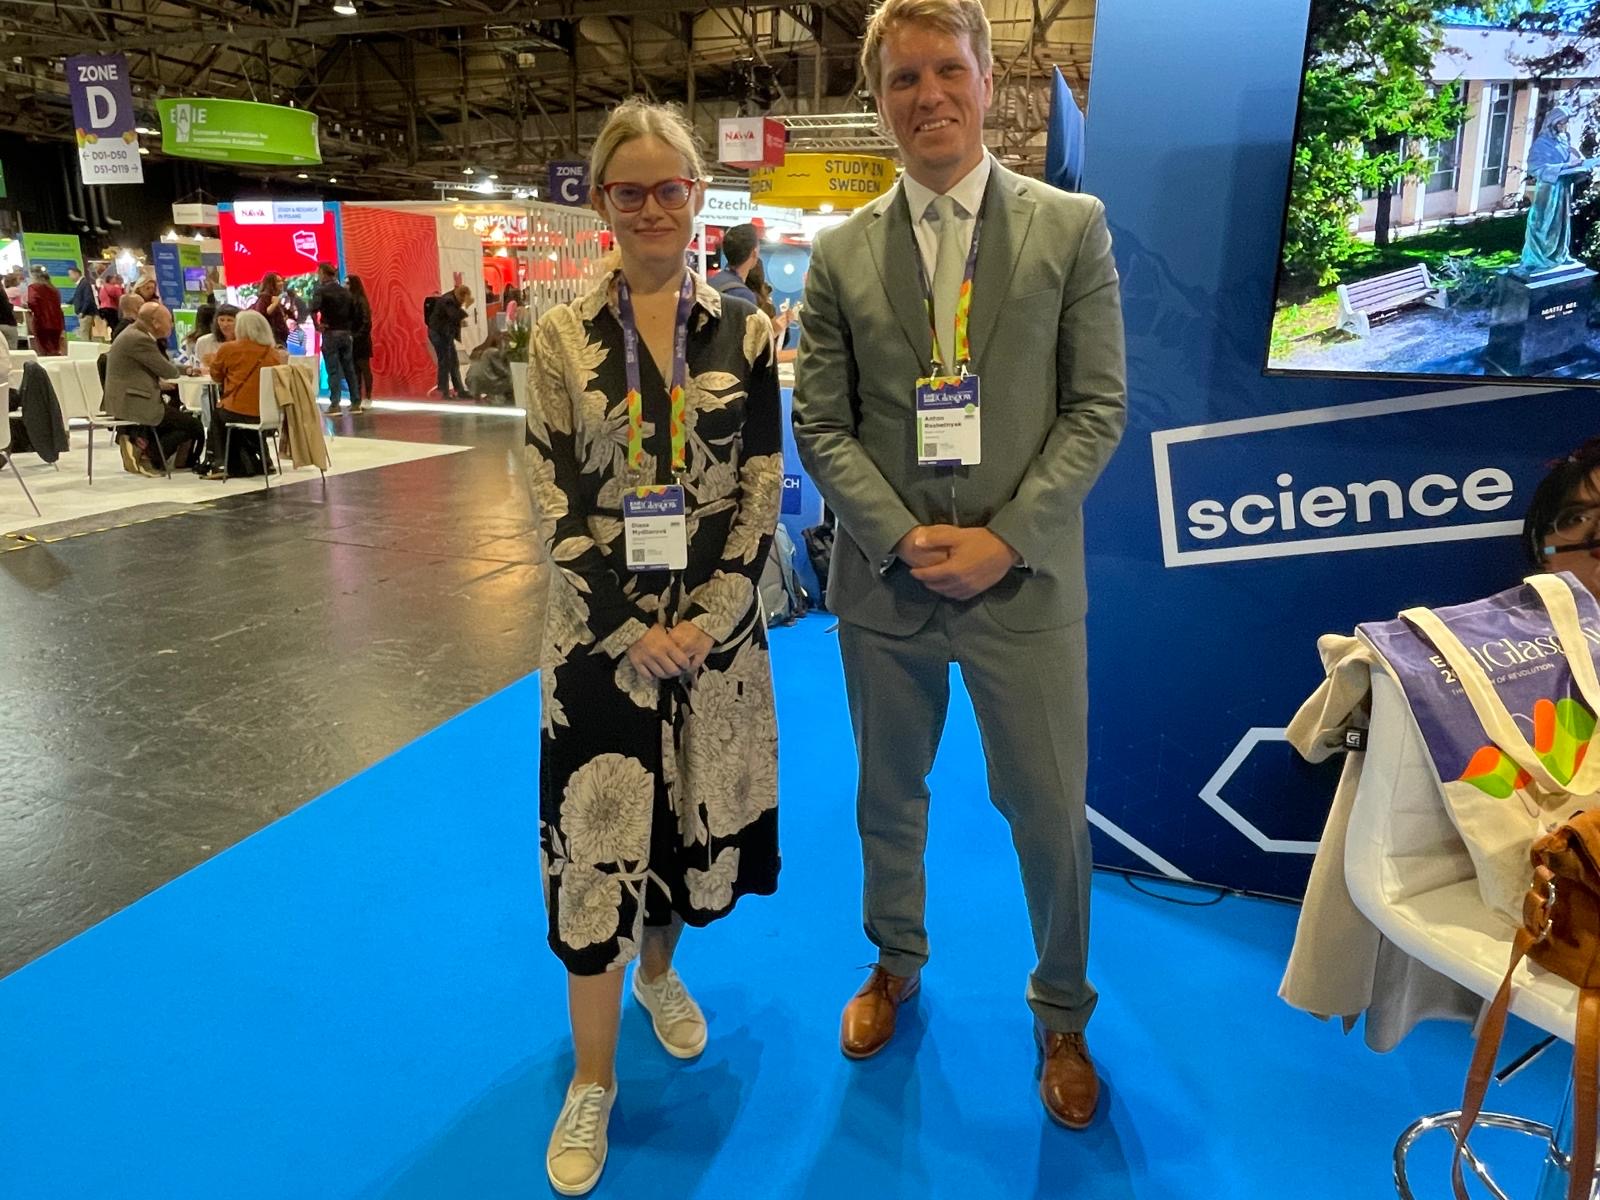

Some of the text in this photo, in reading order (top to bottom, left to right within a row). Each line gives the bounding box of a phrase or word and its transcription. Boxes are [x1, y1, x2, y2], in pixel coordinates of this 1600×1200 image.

[77, 64, 119, 82] ZONE
[86, 85, 117, 128] D
[92, 151, 127, 160] D01-D50
[556, 166, 583, 176] ZONE
[825, 160, 884, 176] STUDY IN
[561, 177, 579, 202] C
[829, 178, 880, 193] SWEDEN
[708, 197, 758, 211] Czechia
[784, 478, 799, 489] CH
[1188, 467, 1514, 540] science
[1496, 675, 1507, 684] OF
[1508, 663, 1555, 680] REVOLUTION
